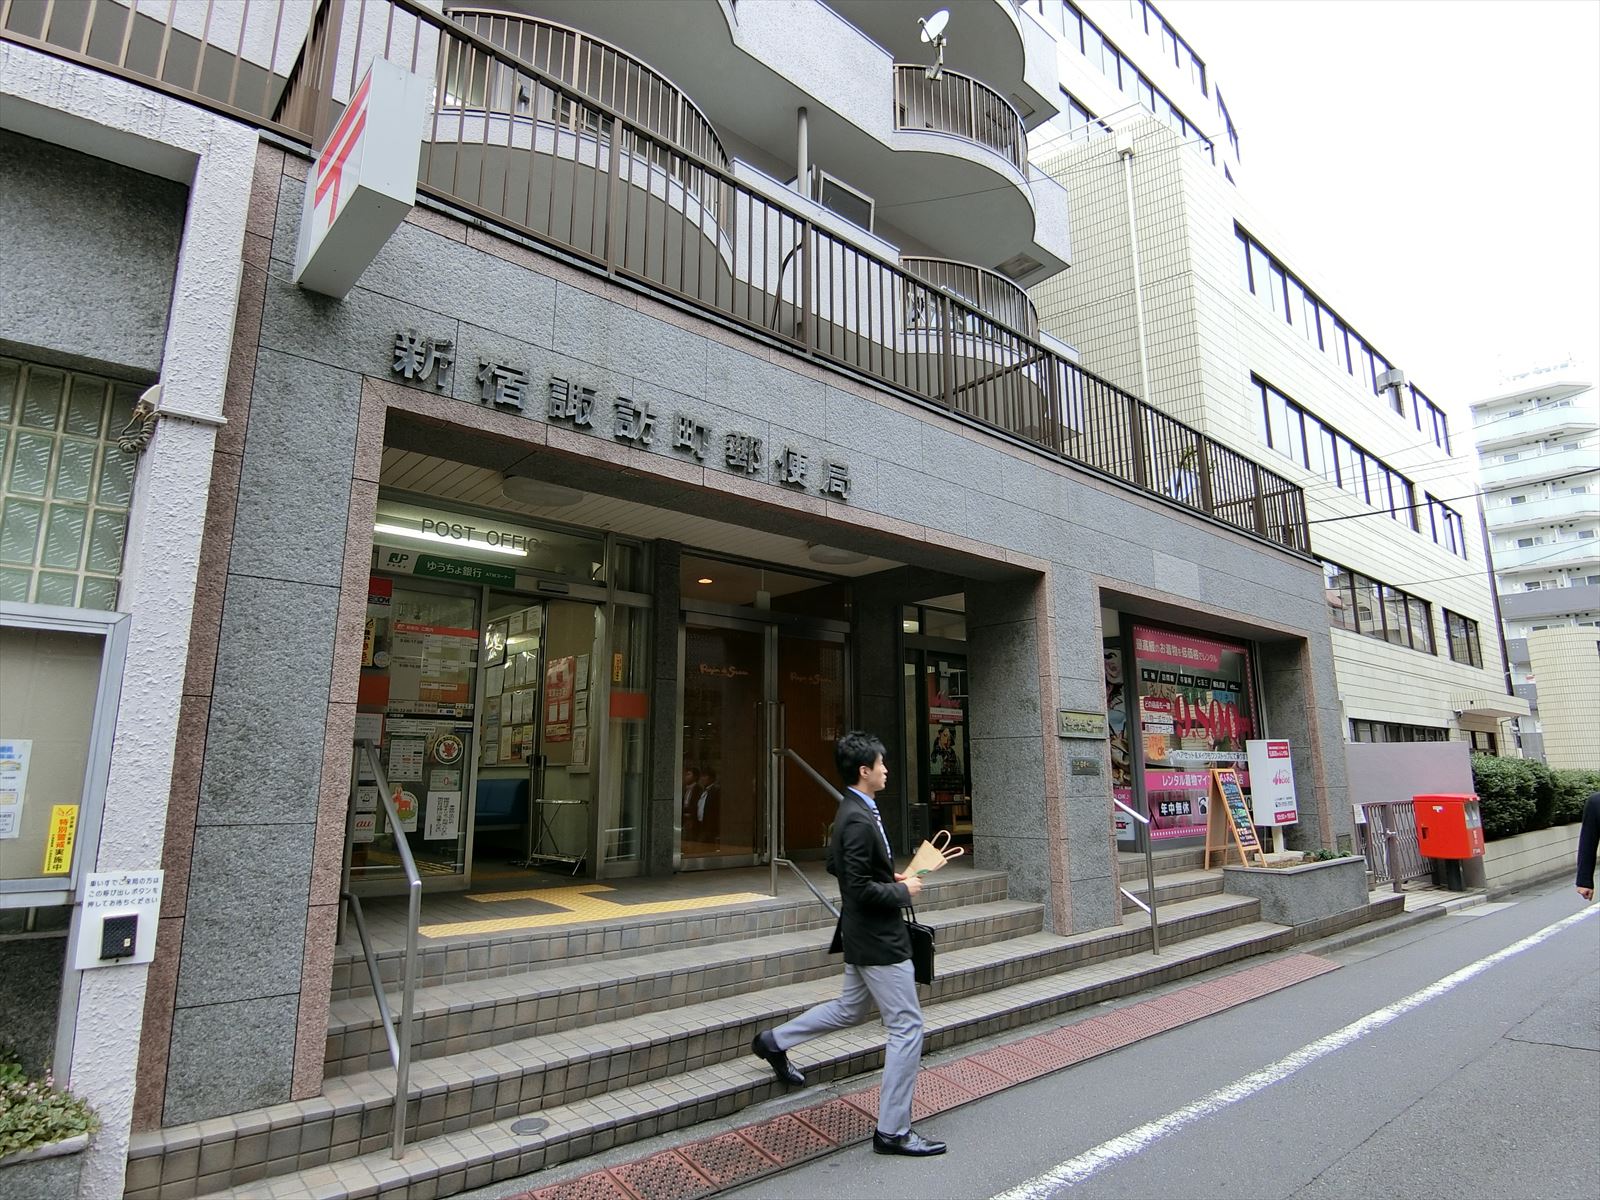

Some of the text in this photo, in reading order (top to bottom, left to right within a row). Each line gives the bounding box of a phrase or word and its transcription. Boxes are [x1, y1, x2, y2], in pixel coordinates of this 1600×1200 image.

[391, 328, 851, 501] 新宿諏訪町郵便局
[421, 518, 549, 554] POST OFFIC
[426, 560, 483, 579] ゆうちょ銀行
[1160, 801, 1190, 816] 年中無休
[52, 818, 69, 871] 特別警戒実施中
[88, 887, 159, 898] この呼び出しボタンを
[87, 897, 158, 908] 押してお待ちください
